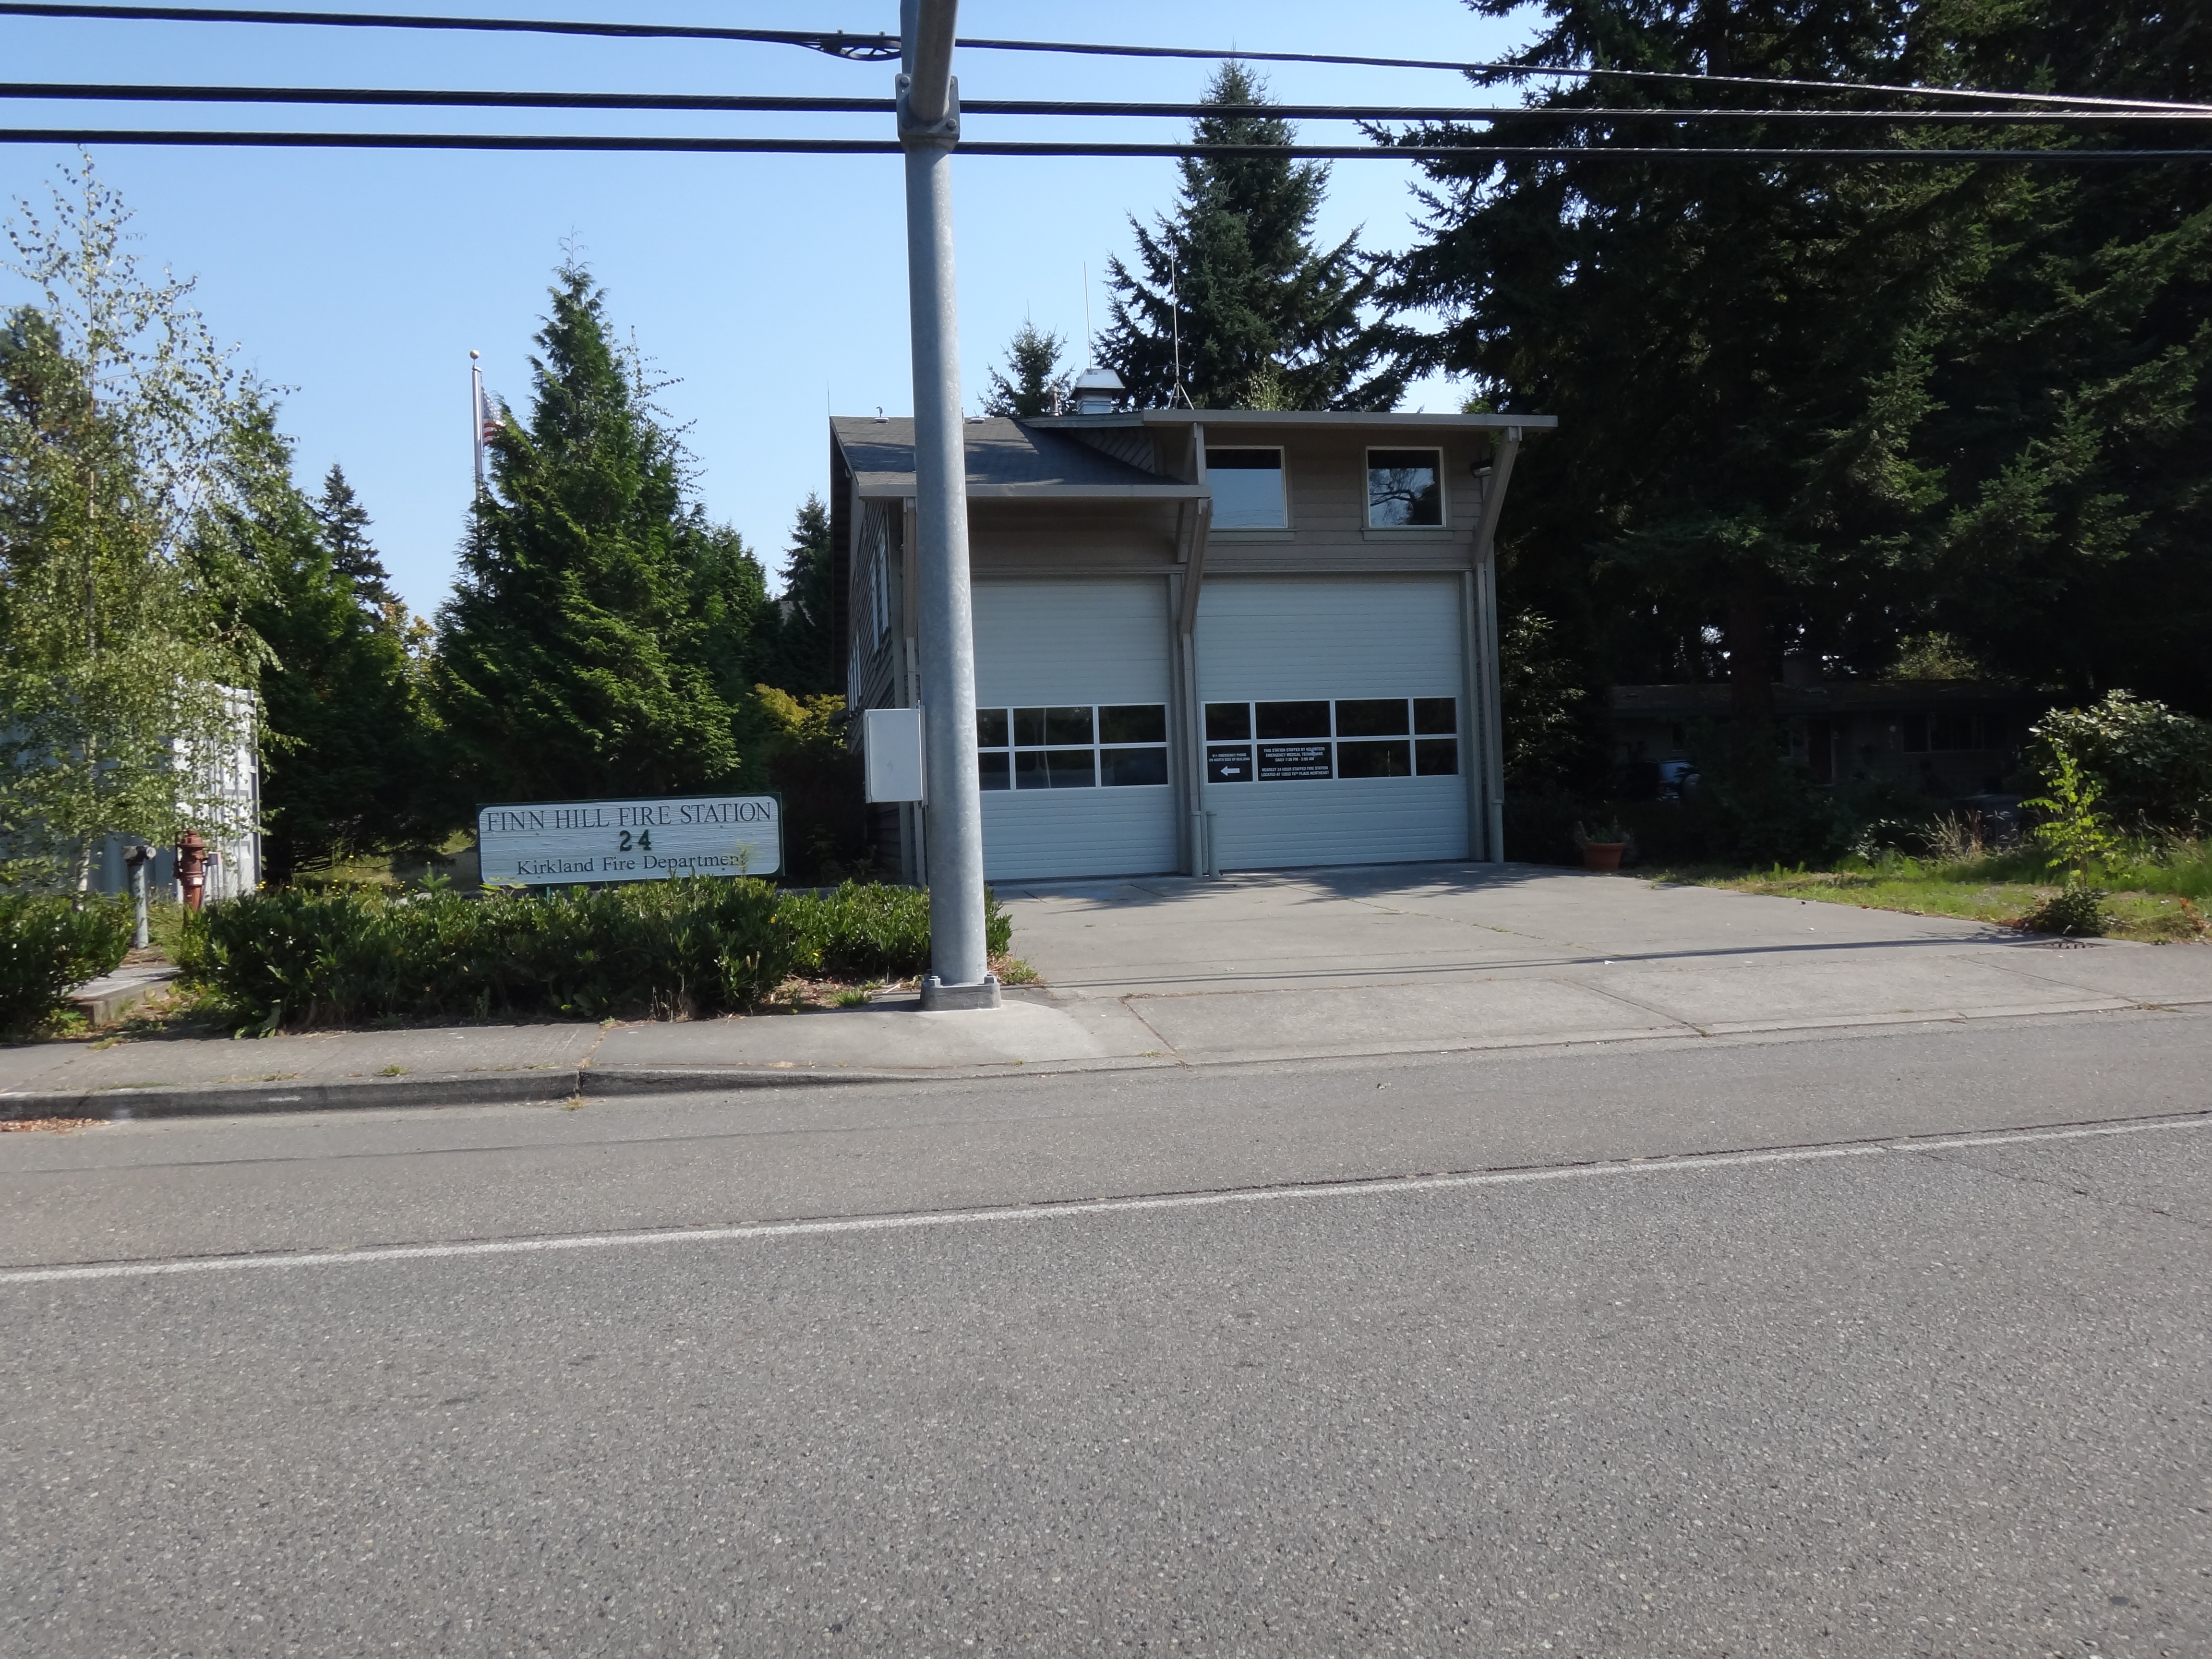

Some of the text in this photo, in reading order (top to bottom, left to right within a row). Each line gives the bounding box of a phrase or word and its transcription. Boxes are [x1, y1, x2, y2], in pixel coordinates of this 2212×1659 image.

[487, 802, 771, 831] FINN HILL FIRE STATION
[619, 829, 651, 852] 24
[517, 854, 746, 875] Kirkland Fire Departmen
